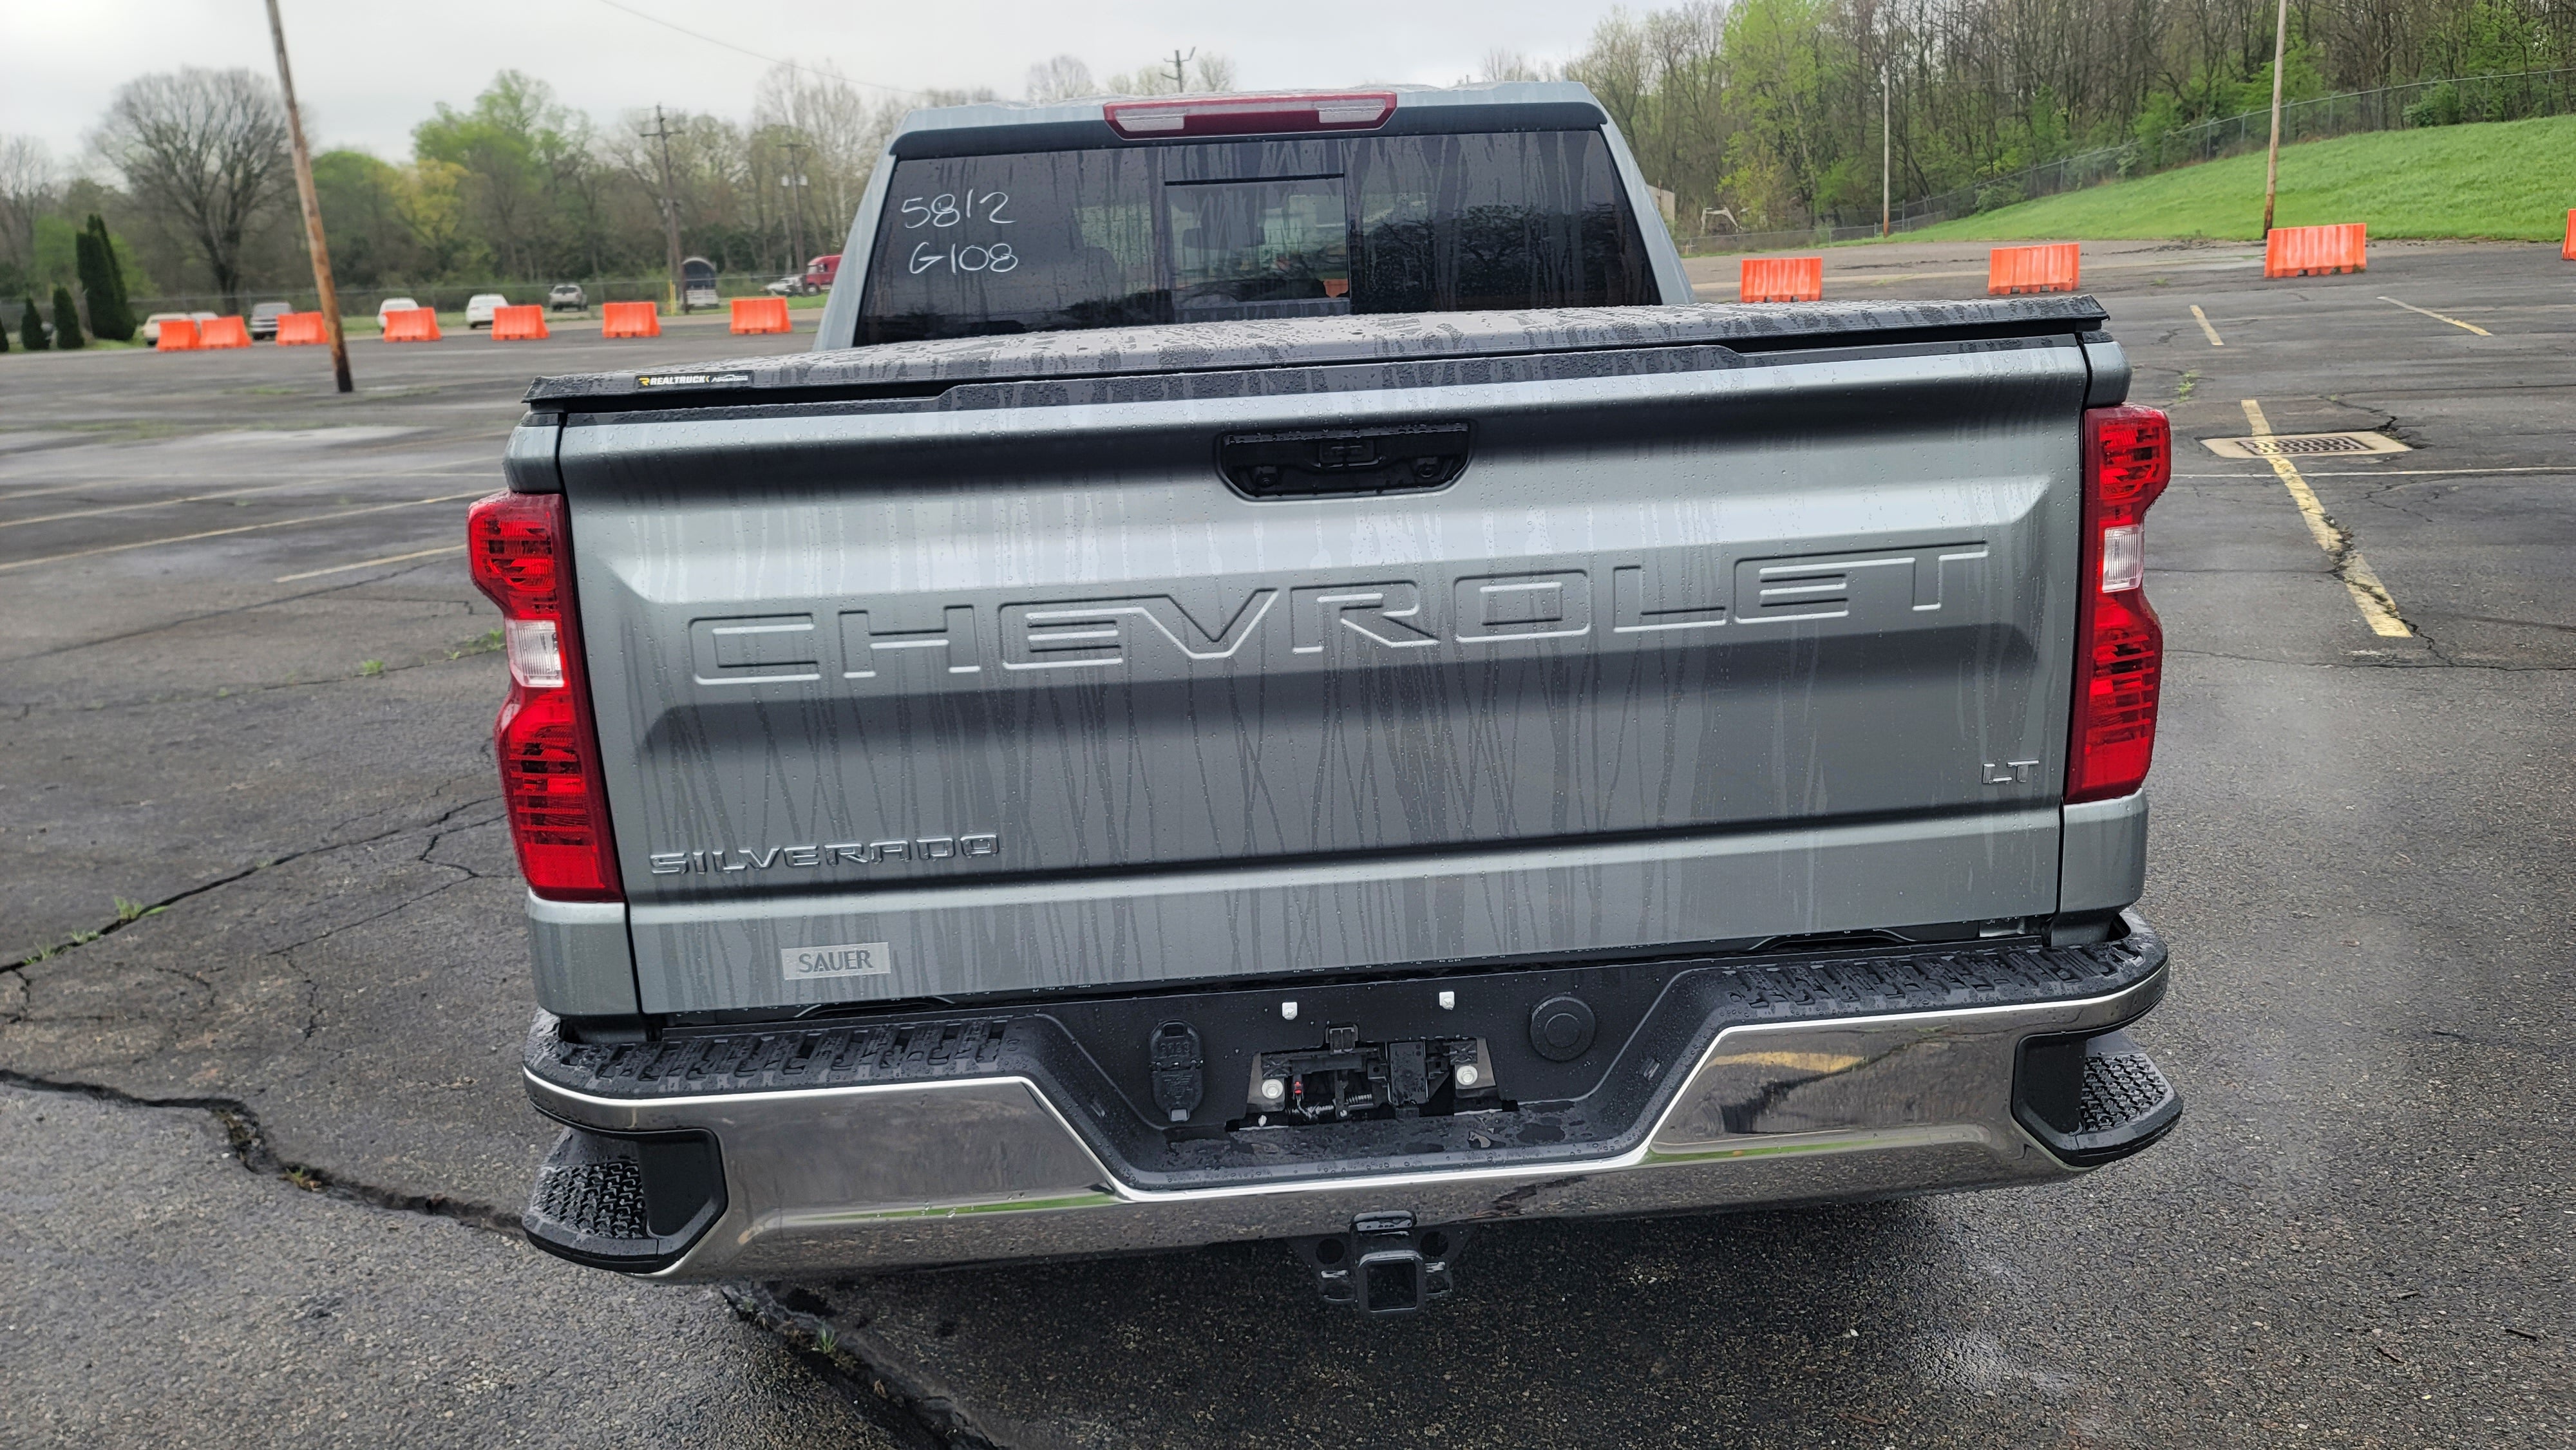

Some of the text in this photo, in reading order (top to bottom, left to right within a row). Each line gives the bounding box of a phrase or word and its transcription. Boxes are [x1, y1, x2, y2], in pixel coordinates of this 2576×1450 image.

[901, 189, 1016, 228] 5812
[909, 241, 1018, 275] G108
[650, 375, 706, 385] REALTRUCK
[688, 540, 1989, 684] CHEVROLET
[1982, 760, 2040, 784] LT
[649, 833, 1000, 874] SILVERADO
[798, 948, 874, 973] SAUER
